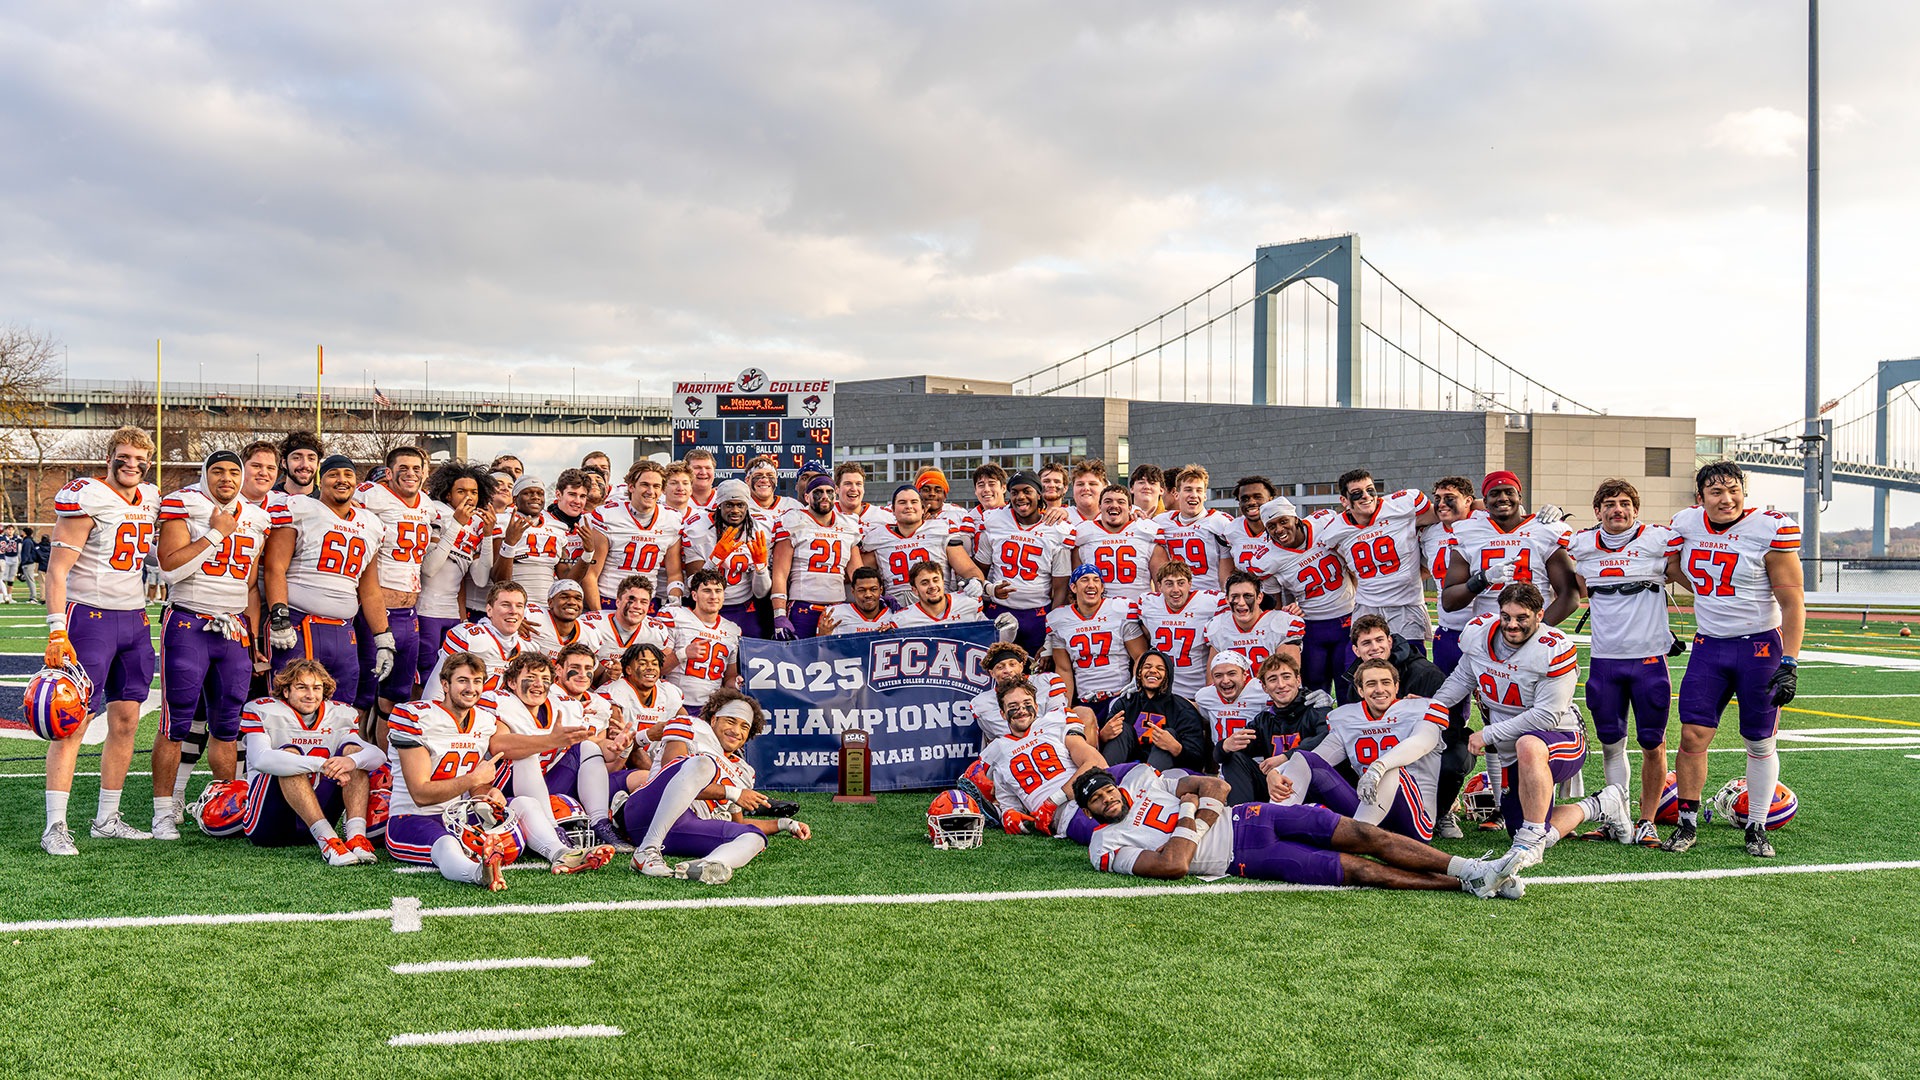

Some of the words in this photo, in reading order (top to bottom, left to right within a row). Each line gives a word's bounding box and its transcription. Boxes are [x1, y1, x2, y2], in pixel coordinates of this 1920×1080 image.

[676, 382, 735, 395] MARITIME
[769, 381, 830, 392] COLLEGE
[731, 398, 761, 406] Welcome
[763, 398, 773, 406] To
[673, 419, 700, 429] HOME
[802, 418, 832, 429] GUEST
[681, 430, 695, 443] 14
[810, 428, 831, 443] 42
[724, 445, 735, 453] TO
[736, 445, 747, 453] GO
[755, 445, 772, 453] BALL
[773, 445, 783, 453] ON
[790, 445, 806, 454] QTR
[731, 454, 745, 468] 10
[794, 455, 803, 468] 4
[124, 513, 147, 521] HOBART
[333, 523, 359, 535] HOBART
[1357, 530, 1383, 541] HOBART
[109, 522, 153, 571] 65
[391, 521, 429, 564] 58
[526, 533, 557, 558] 14
[631, 535, 656, 543] HOBART
[895, 542, 919, 550] HOBART
[1010, 534, 1036, 544] HOBART
[1699, 541, 1729, 550] HOBART
[317, 530, 367, 579] 68
[617, 542, 660, 573] 10
[808, 538, 842, 574] 21
[1000, 540, 1043, 581] 95
[1167, 538, 1209, 575] 59
[1298, 551, 1324, 568] HOBART
[1350, 535, 1400, 579] 89
[1094, 545, 1137, 584] 66
[1297, 554, 1344, 599] 20
[1687, 549, 1739, 597] 57
[700, 632, 722, 642] HOBART
[1069, 631, 1112, 668] 37
[1155, 627, 1196, 667] 27
[685, 637, 729, 681] 26
[872, 641, 990, 686] ECAC
[748, 657, 864, 692] 2025
[1486, 667, 1511, 680] HOBART
[878, 679, 902, 688] EASTERN
[925, 678, 951, 686] ATHLETIC
[845, 733, 866, 741] ECAC
[1362, 727, 1392, 736] HOBART
[773, 751, 839, 766] JAMES
[871, 747, 915, 766] NAH
[920, 743, 979, 761] BOWL
[1012, 739, 1039, 755] HOBART
[715, 757, 735, 779] HOBART
[1010, 742, 1066, 795] 88
[1132, 797, 1152, 827] HOBART
